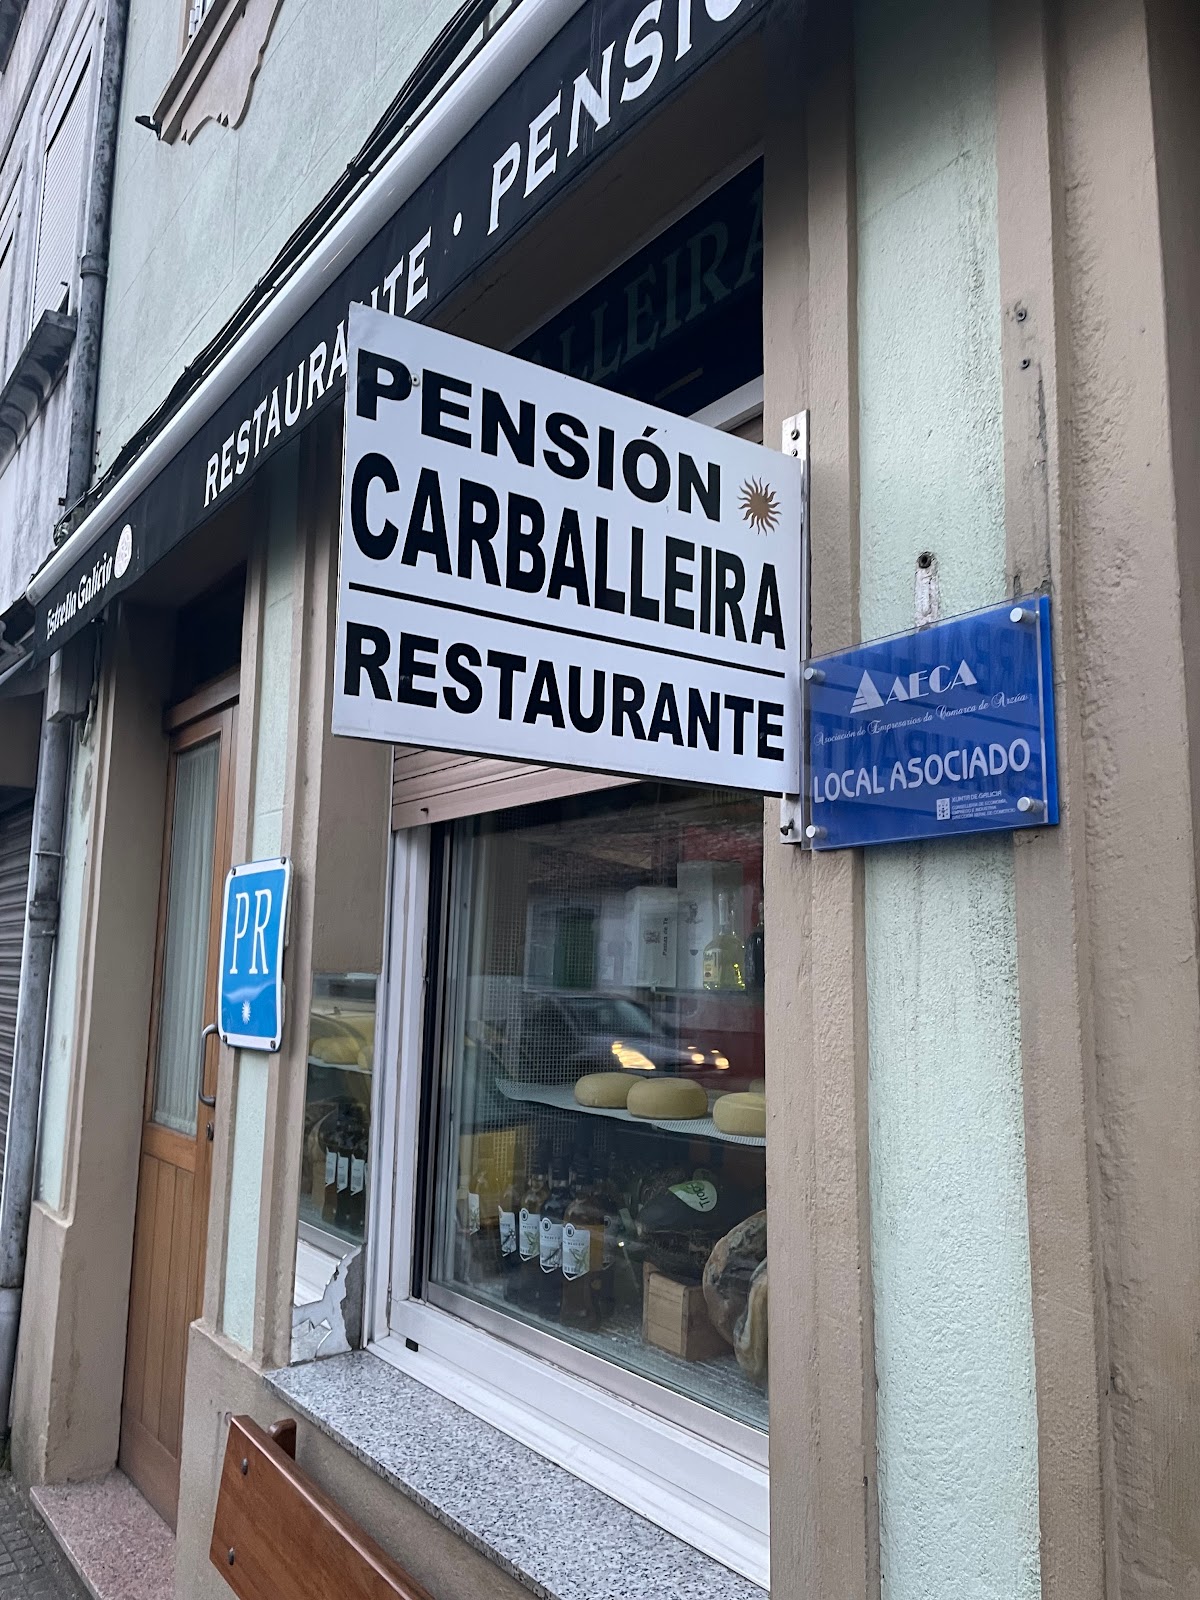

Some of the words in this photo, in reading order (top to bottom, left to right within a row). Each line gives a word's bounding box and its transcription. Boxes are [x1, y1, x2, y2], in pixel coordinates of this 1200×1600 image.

[531, 181, 763, 383] LLEIR
[356, 348, 722, 523] PENSIÓN
[46, 590, 77, 641] Estrella
[77, 552, 113, 610] Galicia
[350, 452, 786, 651] CARBALLEIRA
[343, 621, 785, 762] RESTAURANTE
[867, 716, 923, 735] Empresarios
[936, 704, 977, 720] Comarca
[978, 699, 989, 710] de
[991, 691, 1028, 708] Arzúa
[814, 765, 885, 803] LOCAL
[890, 738, 1031, 791] ASOCIADO
[229, 888, 273, 975] PR
